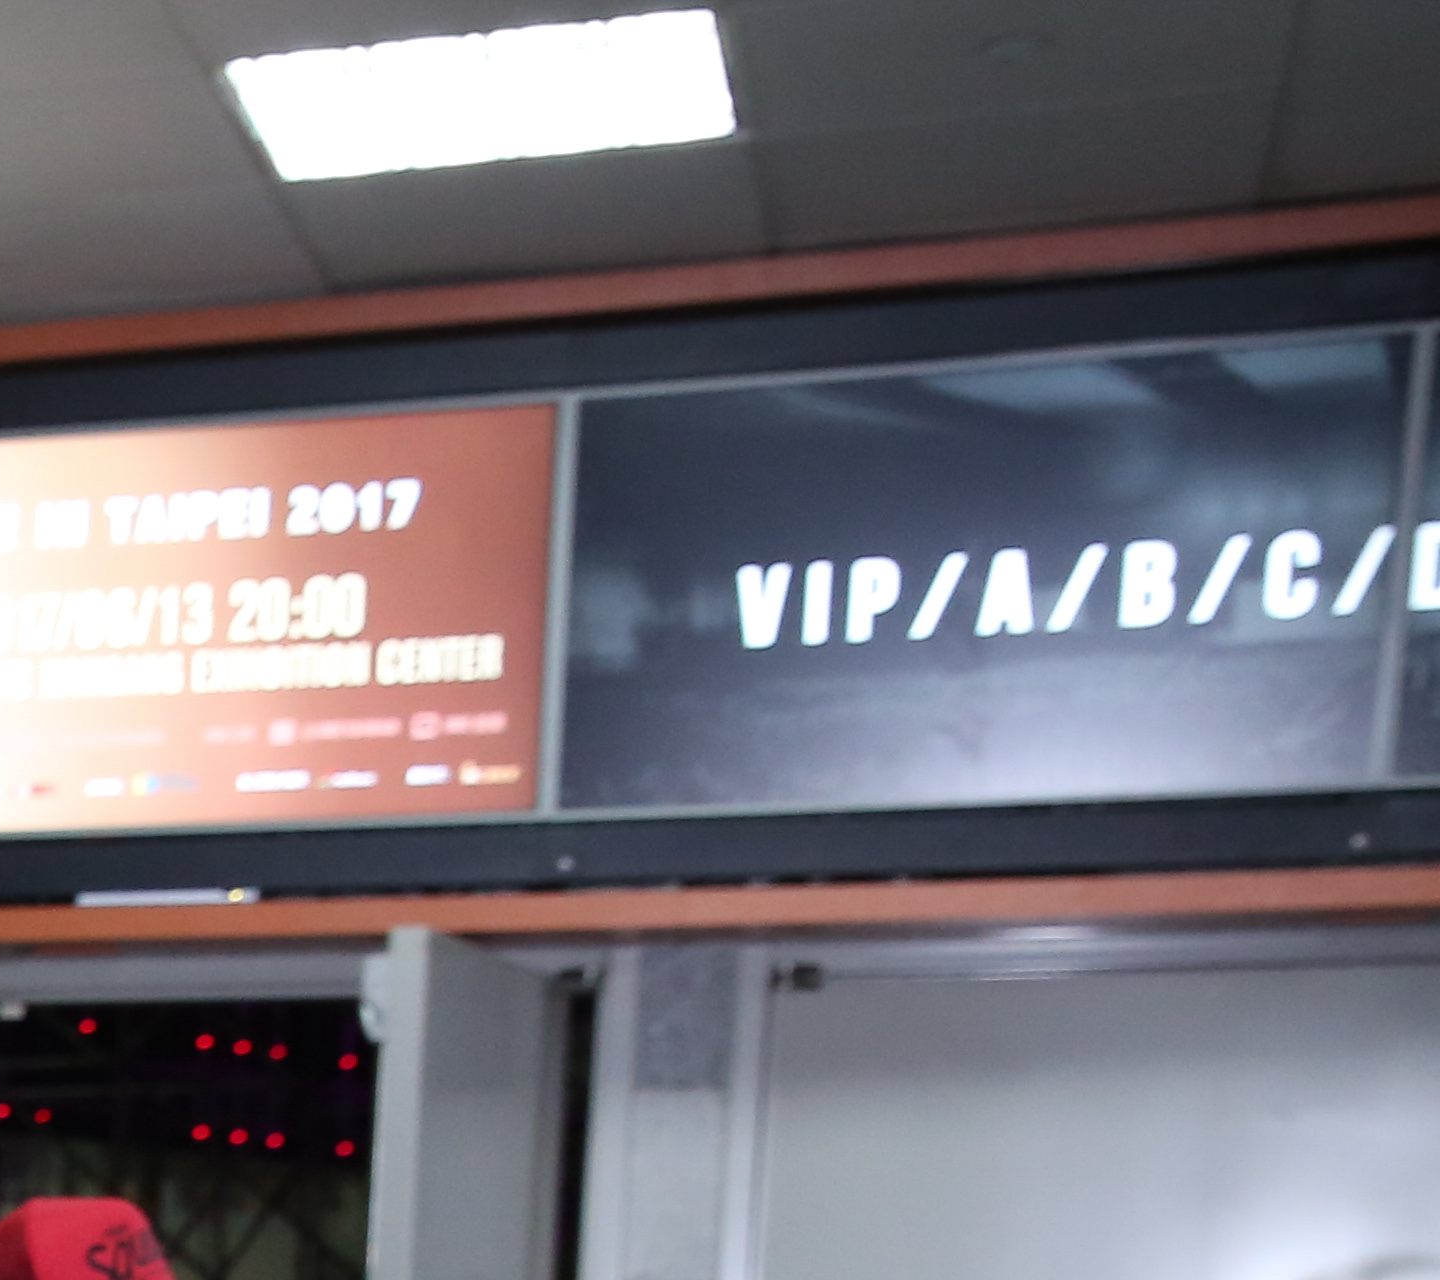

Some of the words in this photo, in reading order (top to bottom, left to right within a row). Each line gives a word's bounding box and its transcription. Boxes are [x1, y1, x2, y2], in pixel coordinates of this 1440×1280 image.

[104, 487, 271, 546] TAIPEI
[286, 477, 422, 537] 2017
[227, 573, 367, 643] 20:00
[376, 635, 505, 686] CENTER
